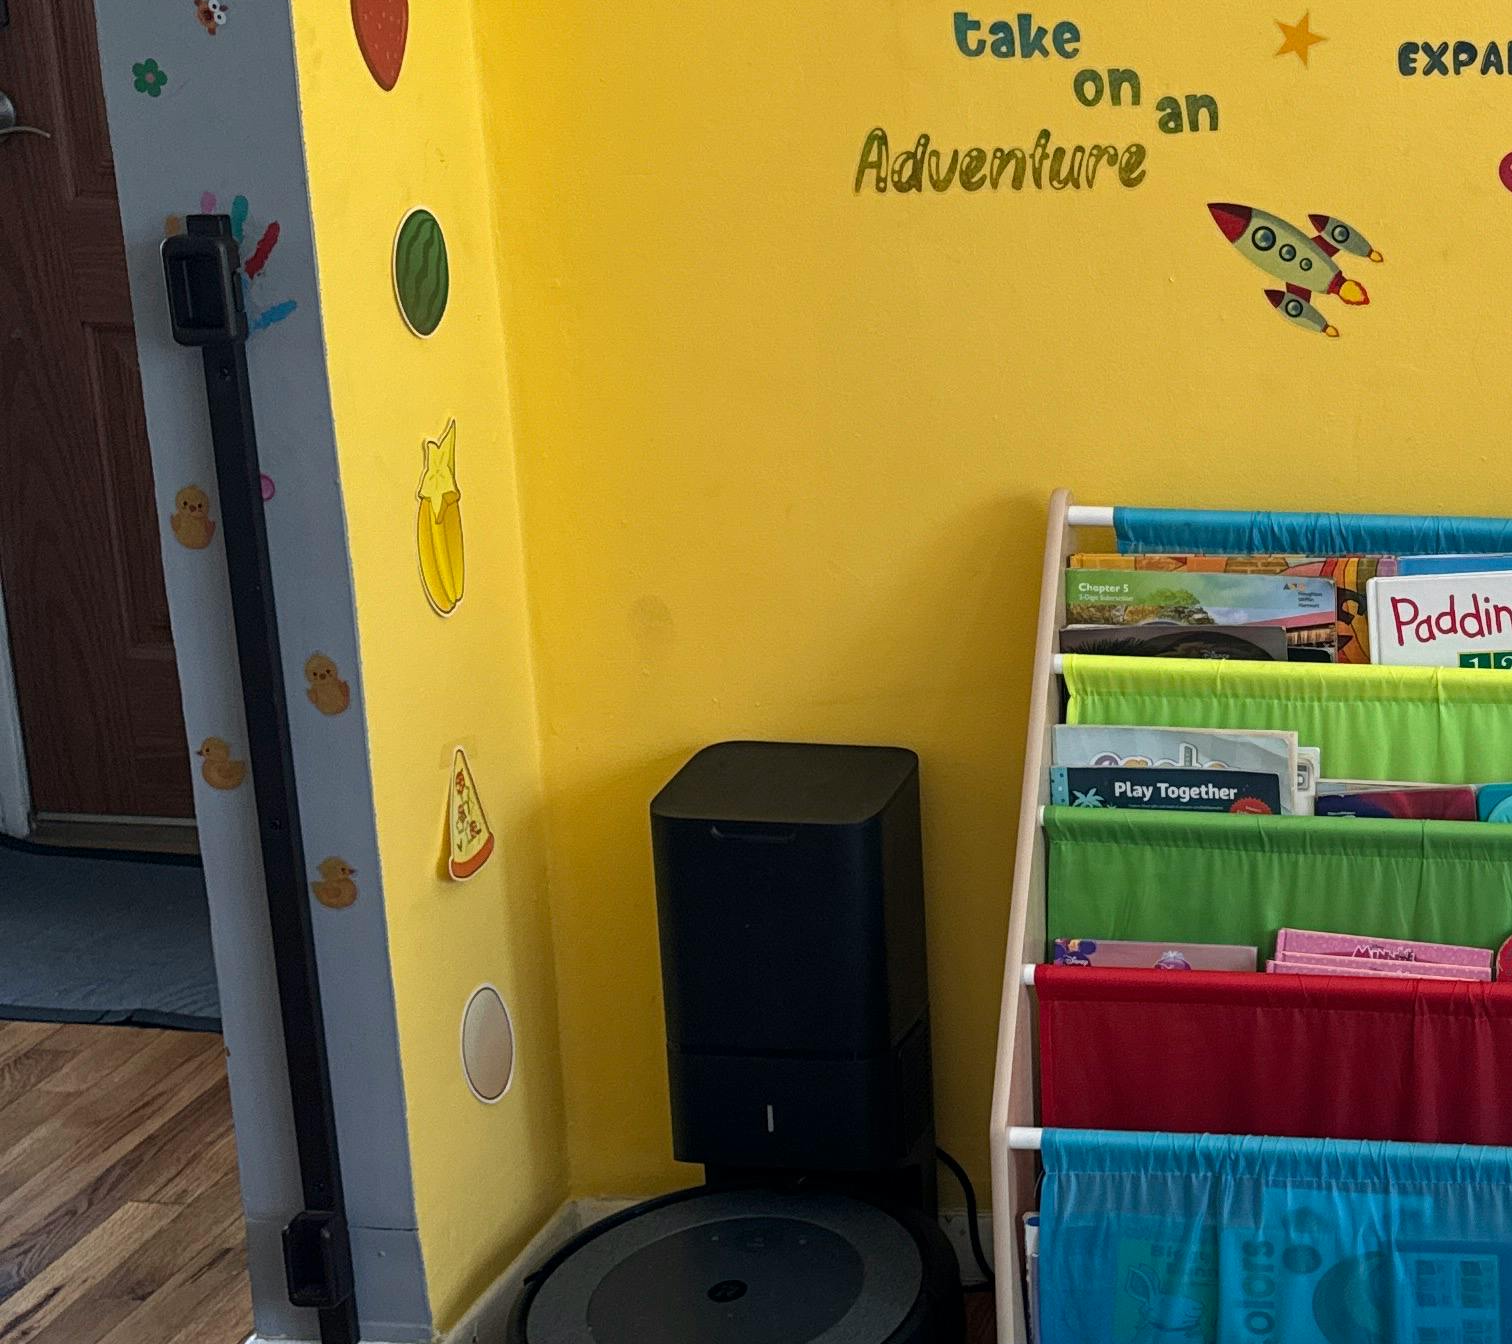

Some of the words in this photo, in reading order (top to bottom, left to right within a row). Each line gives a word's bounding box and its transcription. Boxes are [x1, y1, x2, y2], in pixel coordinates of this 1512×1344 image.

[953, 11, 1081, 59] take
[1073, 68, 1141, 106] on
[1155, 94, 1219, 133] an
[855, 127, 1146, 193] Adventure
[1078, 582, 1121, 594] Chapter
[1123, 583, 1129, 593] 5
[1114, 781, 1154, 802] Play
[1156, 782, 1239, 801] Together
